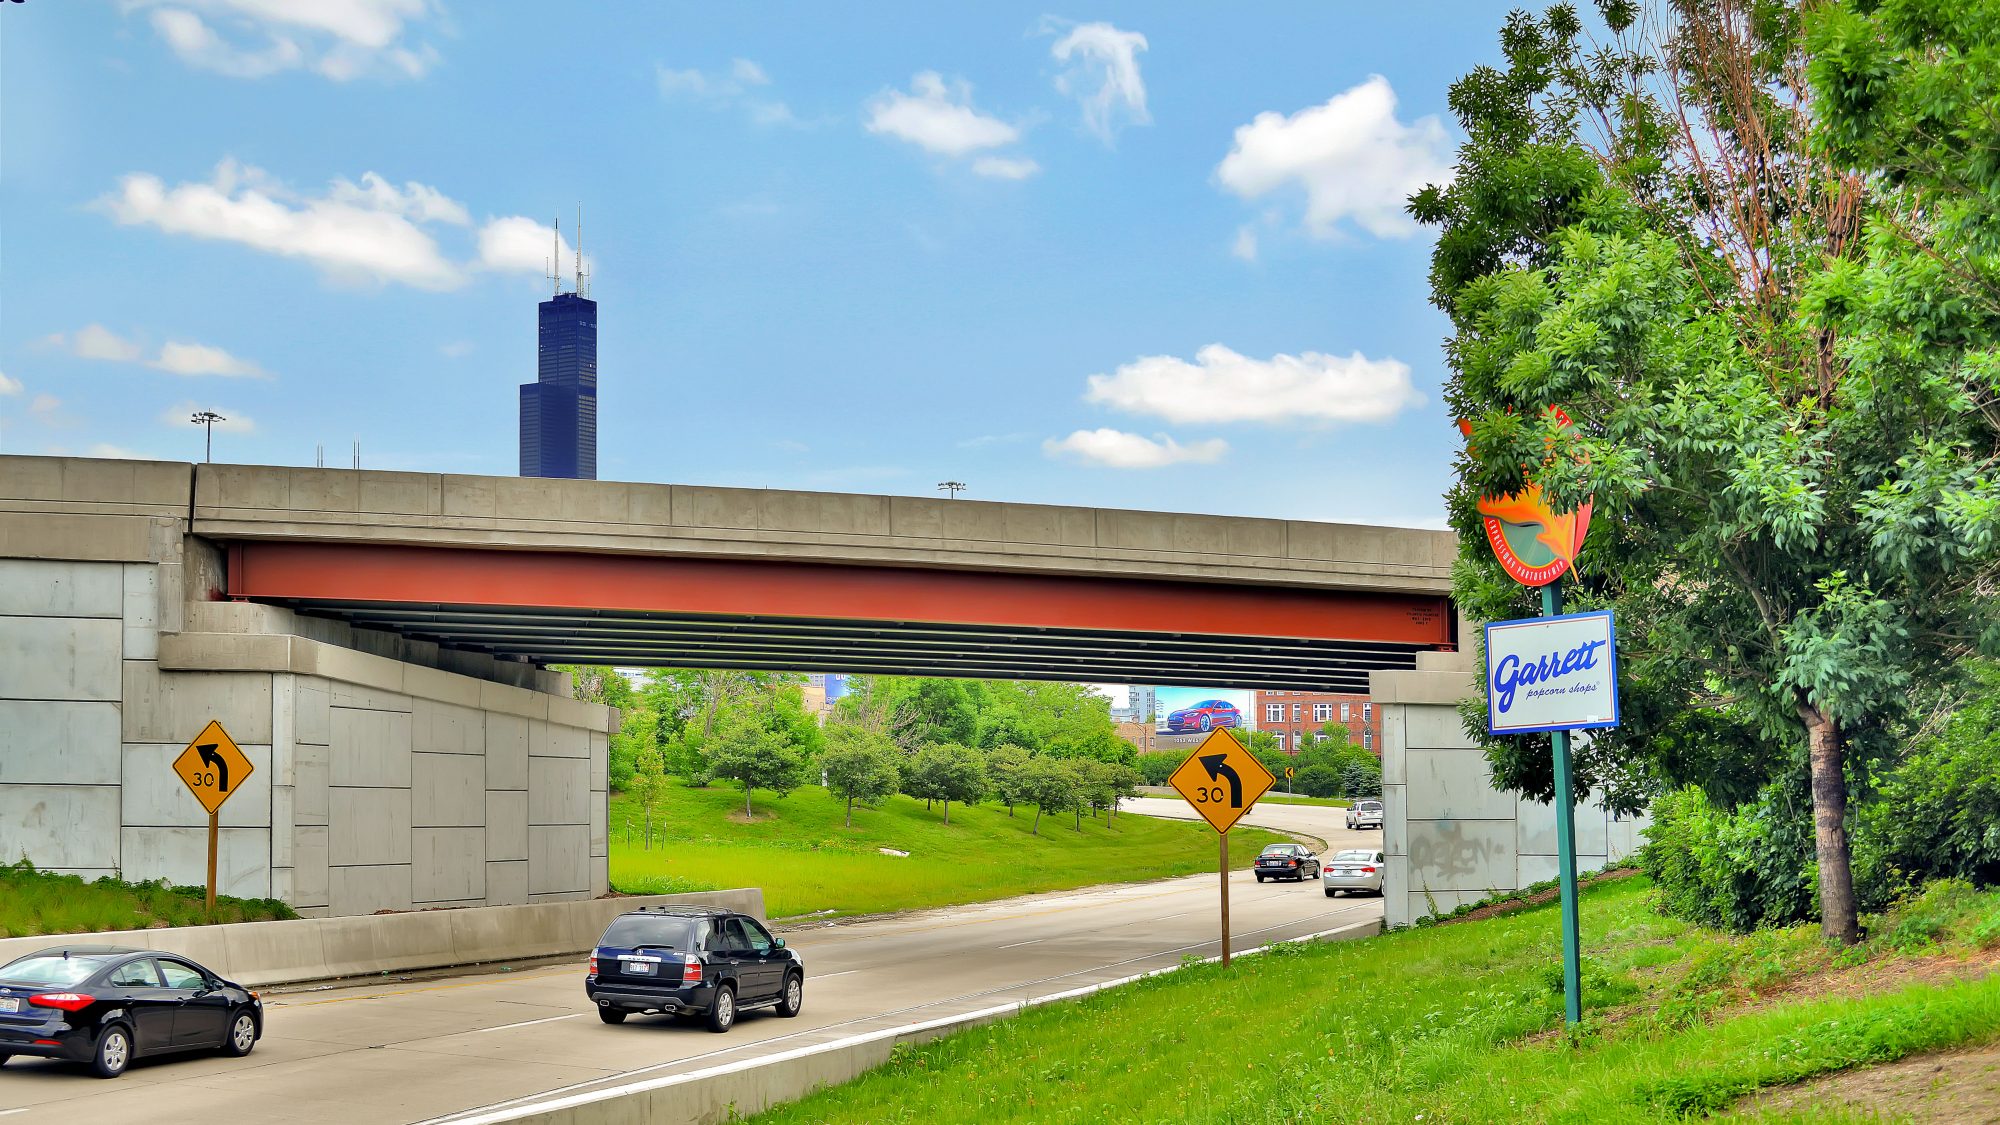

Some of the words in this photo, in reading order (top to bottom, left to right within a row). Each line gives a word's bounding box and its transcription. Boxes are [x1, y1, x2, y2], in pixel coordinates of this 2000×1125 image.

[1488, 519, 1516, 569] EXPRESSWAY
[1516, 560, 1564, 581] PARTNERSHIP
[1494, 639, 1606, 713] Garrett
[1526, 687, 1566, 700] popcorn
[1568, 682, 1598, 695] shops
[193, 772, 214, 787] 30
[1196, 787, 1224, 803] 30
